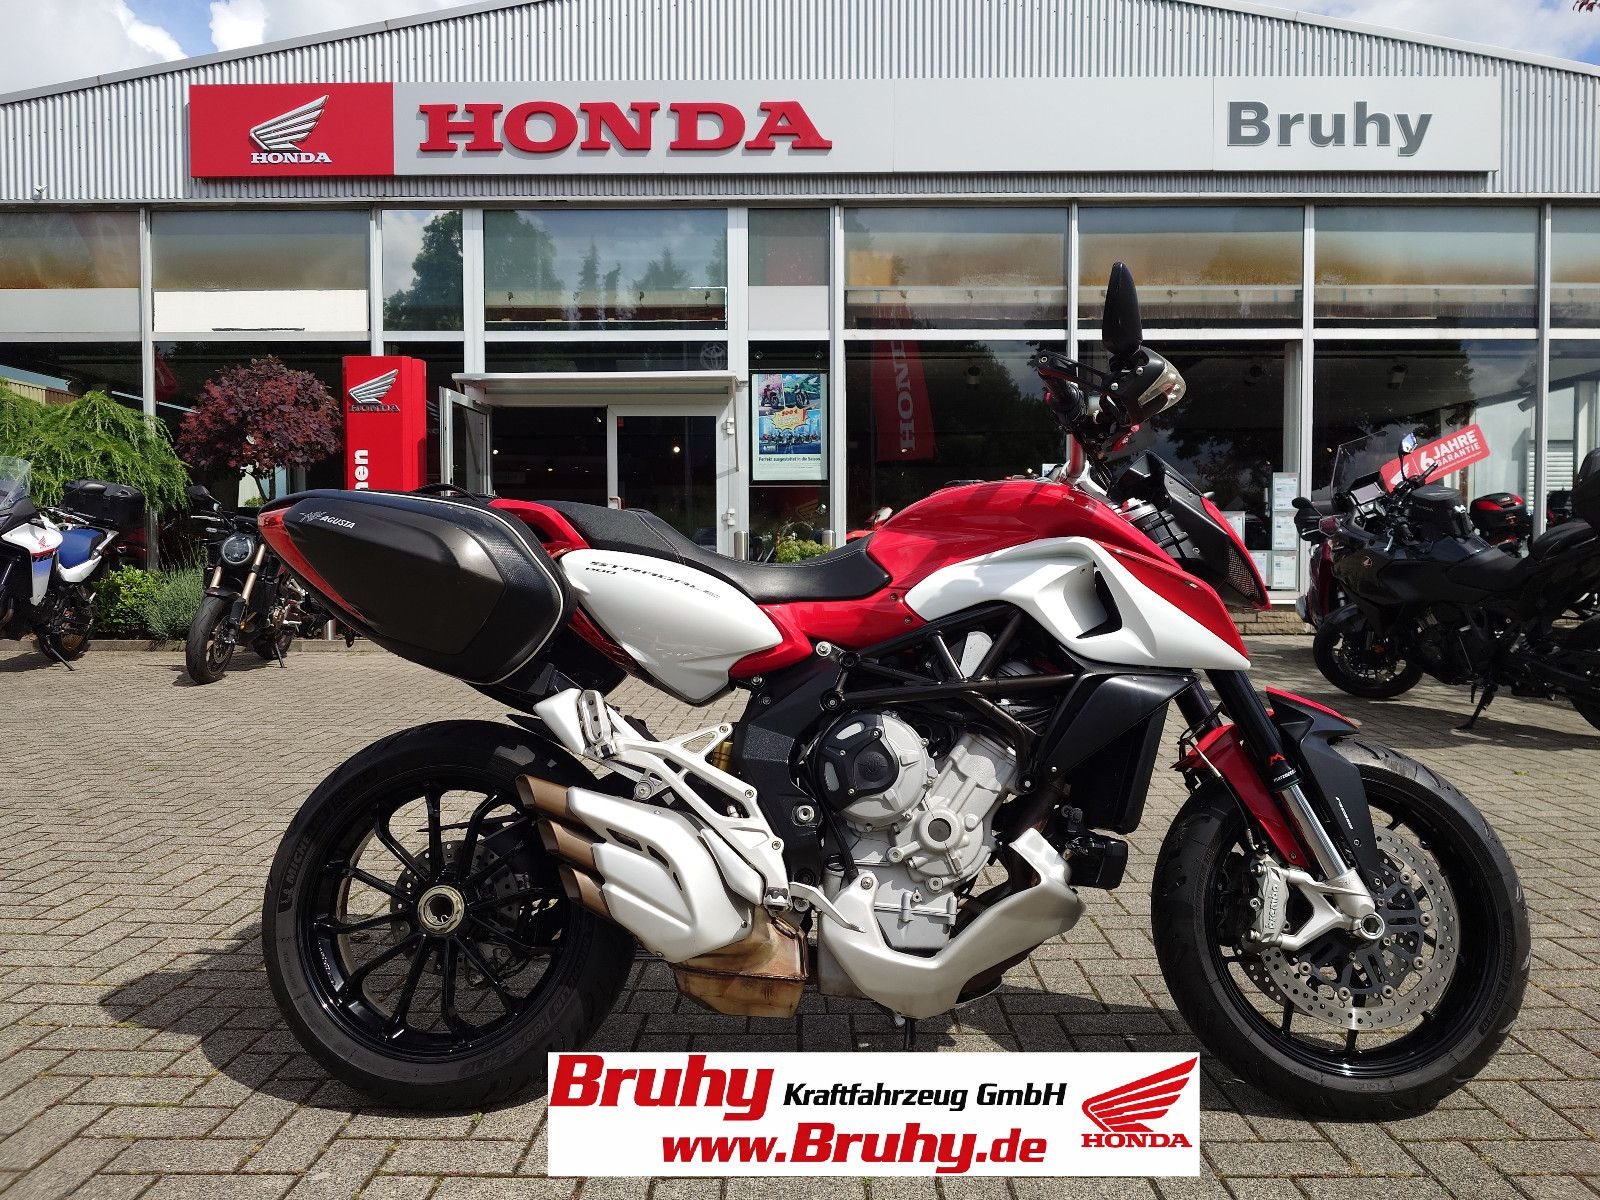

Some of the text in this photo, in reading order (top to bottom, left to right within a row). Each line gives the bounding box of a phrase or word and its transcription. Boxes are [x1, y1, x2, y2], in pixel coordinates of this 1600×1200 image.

[419, 101, 832, 152] HONDA
[1227, 100, 1433, 157] Bruhy
[251, 152, 332, 164] HONDA
[349, 404, 400, 412] HONDA
[1433, 429, 1478, 460] JAHRE
[1435, 442, 1480, 467] GARANTIE
[320, 515, 356, 529] AGUSTA
